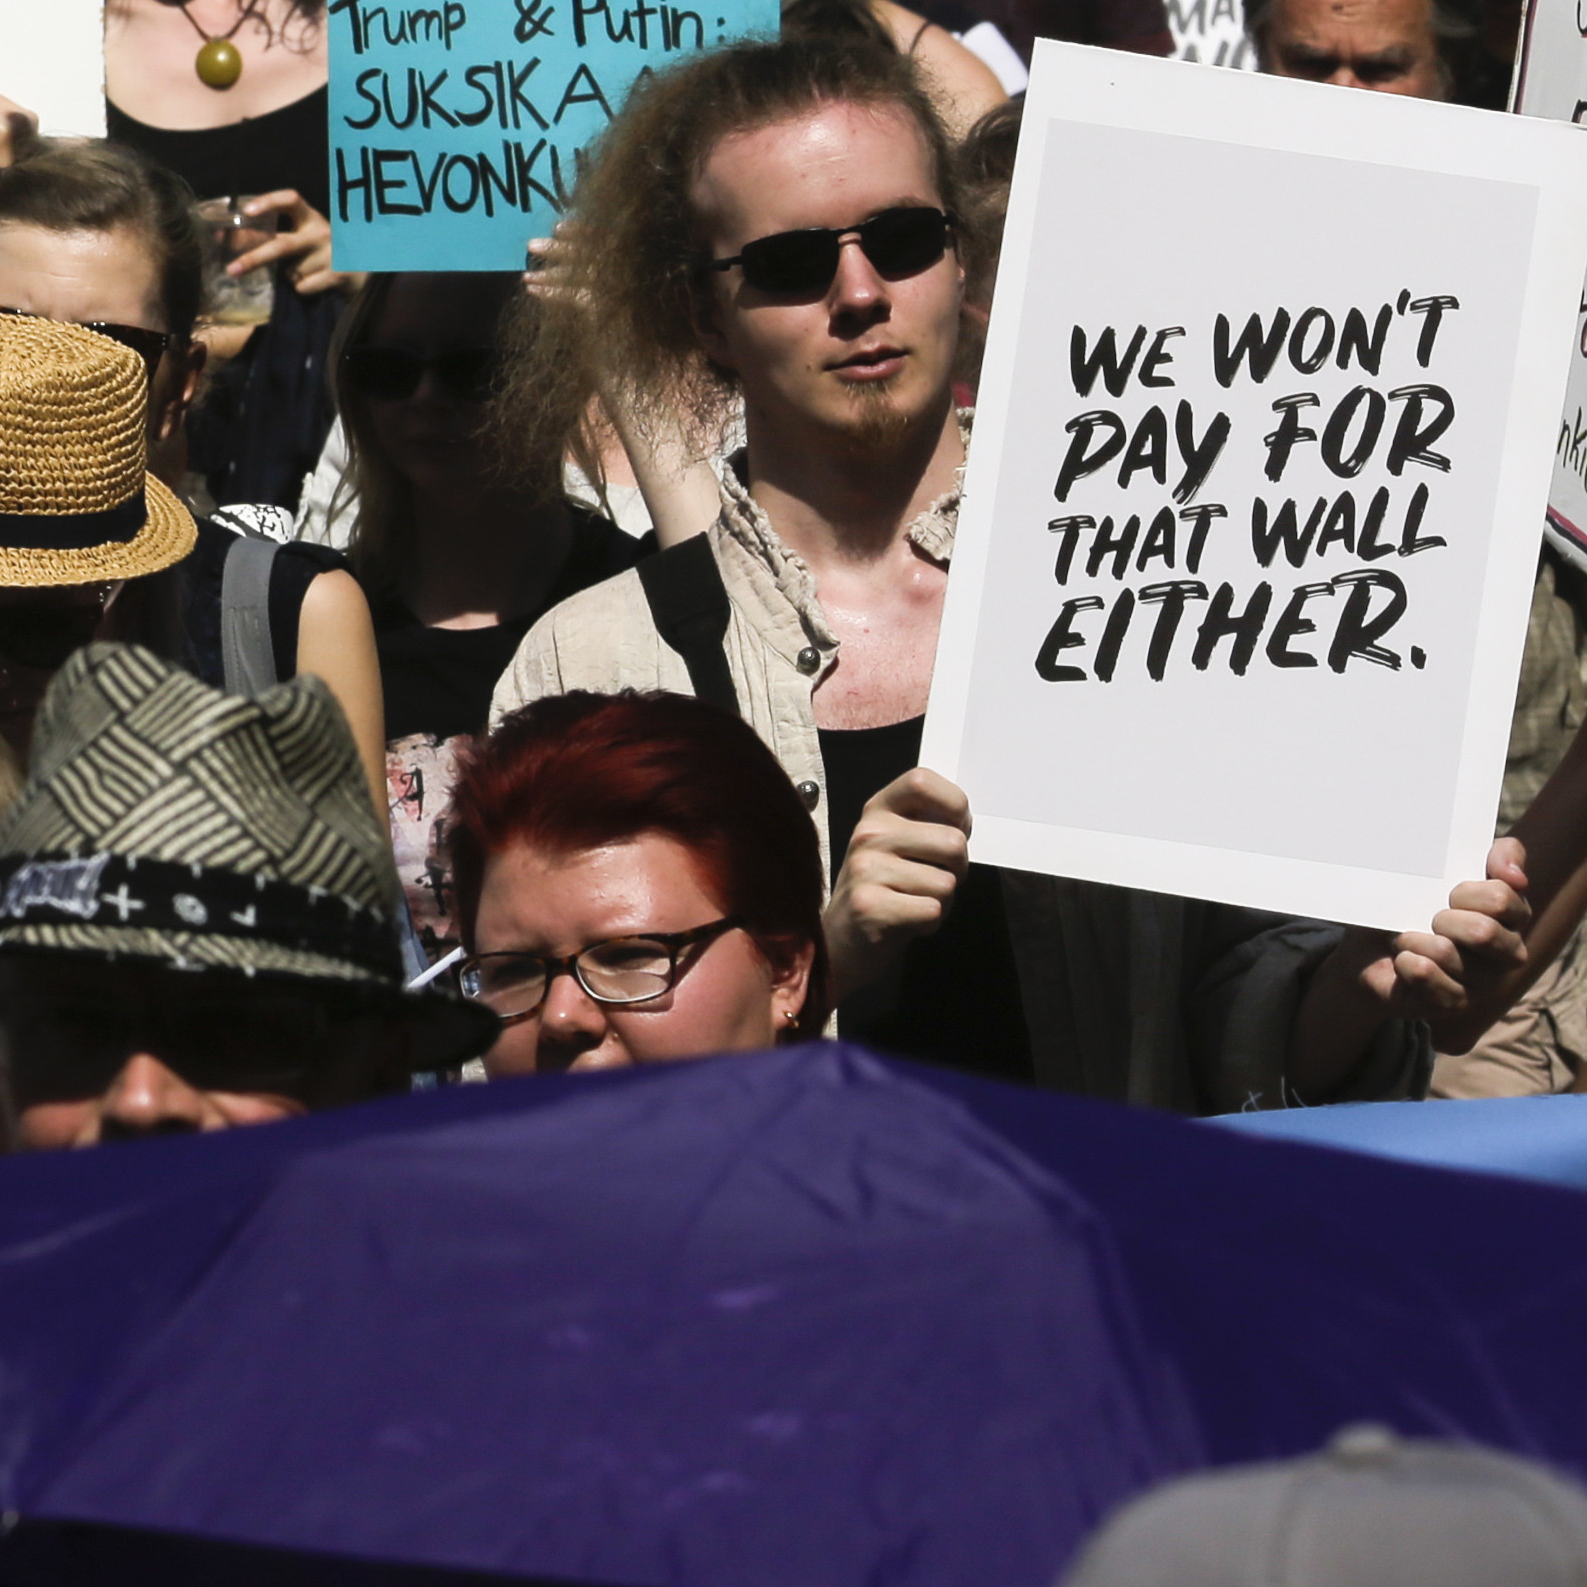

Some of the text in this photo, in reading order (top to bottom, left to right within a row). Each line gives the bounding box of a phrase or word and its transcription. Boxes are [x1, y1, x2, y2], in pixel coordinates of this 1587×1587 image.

[1070, 288, 1460, 398] WE WON'T
[1054, 399, 1232, 505] PAY
[1263, 384, 1455, 483] FOR
[1047, 483, 1448, 586] THAT WALL
[1034, 568, 1427, 683] EITHER.
